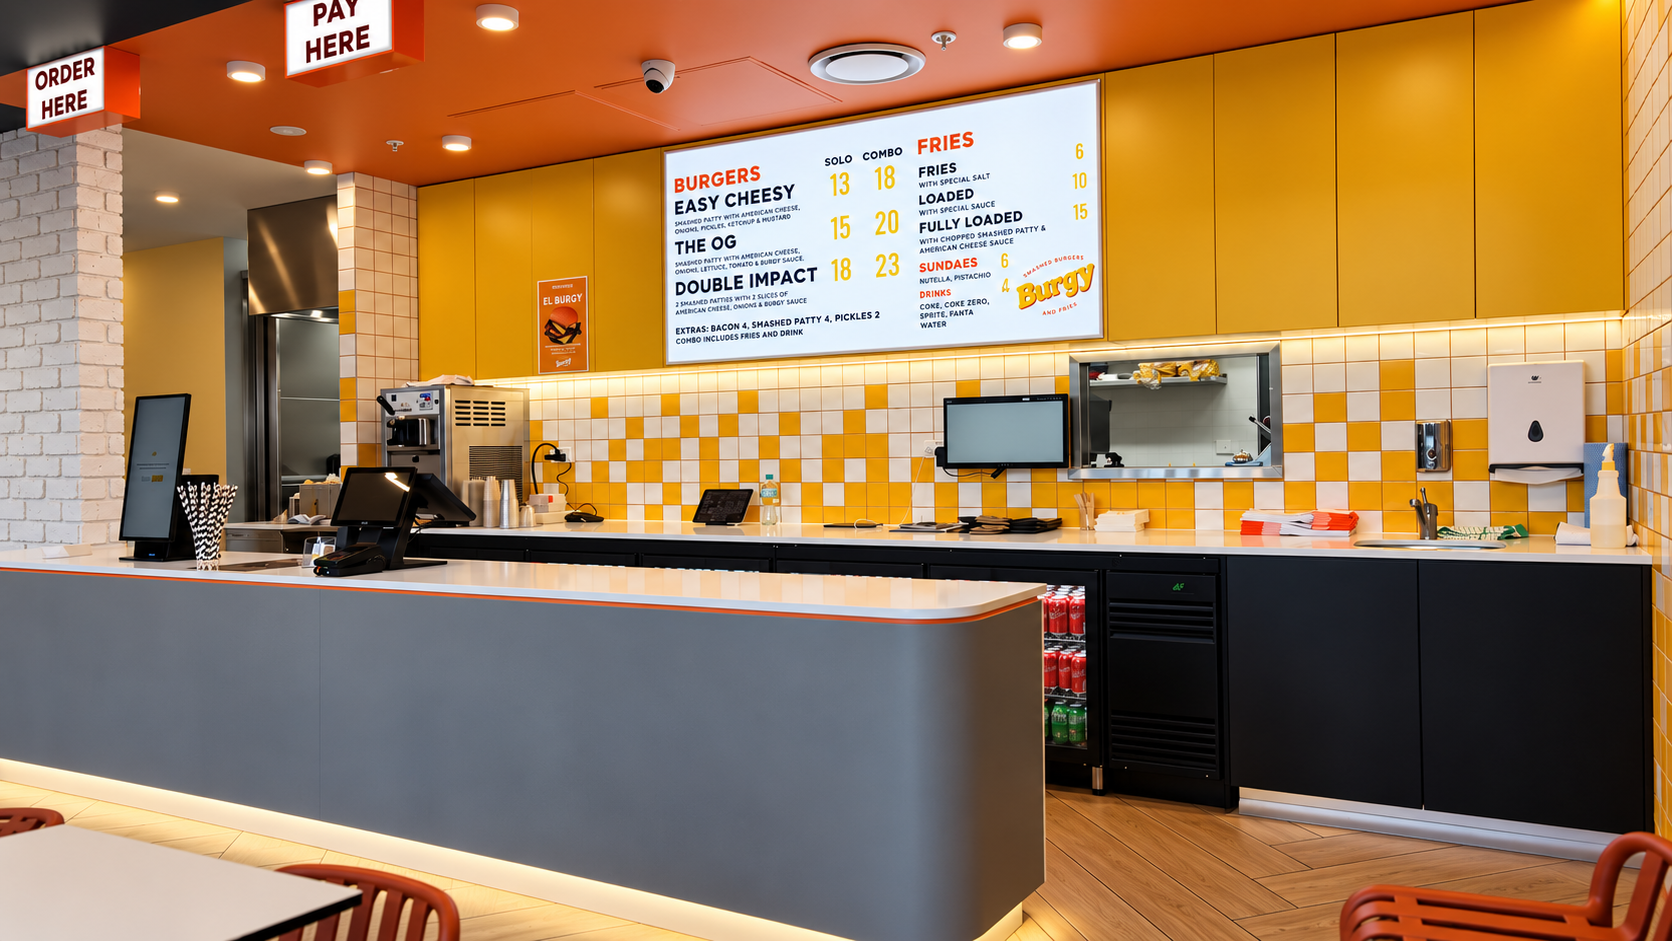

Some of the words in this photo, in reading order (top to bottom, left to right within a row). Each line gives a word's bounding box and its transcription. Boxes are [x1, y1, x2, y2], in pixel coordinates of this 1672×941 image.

[313, 0, 358, 27] PAY
[306, 24, 370, 64] HERE
[35, 57, 95, 91] ORDER
[41, 89, 88, 120] HERE
[917, 131, 974, 155] FRIES
[1075, 143, 1084, 160] 6
[824, 154, 853, 166] SOLO
[862, 147, 903, 161] COMBO
[918, 162, 957, 178] FRIES
[674, 165, 761, 193] BURGERS
[830, 171, 850, 196] 13
[874, 165, 895, 190] 18
[918, 180, 938, 189] WITH
[939, 176, 970, 186] SPECIAL
[972, 172, 991, 181] SALT
[1072, 172, 1087, 189] 10
[675, 195, 719, 215] EASY
[724, 184, 795, 207] CHEESY
[918, 188, 974, 205] LOADED
[741, 209, 774, 218] AMERICAN
[919, 208, 938, 216] WITH
[939, 204, 969, 214] SPECIAL
[971, 200, 996, 210] SAUCE
[1073, 203, 1088, 220] 15
[830, 215, 851, 240] 15
[875, 209, 899, 236] 20
[919, 218, 961, 234] FULLY
[965, 210, 1023, 228] LOADED
[919, 237, 938, 245] WITH
[940, 233, 975, 243] CHOPPED
[977, 228, 1013, 239] SMASHED
[1015, 226, 1039, 234] PATTY
[674, 239, 706, 255] THE
[711, 234, 737, 251] OG
[919, 243, 957, 254] AMERICAN
[959, 241, 987, 250] CHEESE
[989, 237, 1014, 247] SAUCE
[741, 251, 773, 260] AMERICAN
[1001, 252, 1009, 268] 6
[831, 257, 851, 282] 18
[875, 252, 900, 278] 23
[919, 257, 978, 273] SUNDAES
[675, 274, 744, 296] DOUBLE
[749, 267, 817, 288] IMPACT
[919, 275, 952, 285] NUTELLA,
[954, 271, 991, 281] PISTACHIO
[1001, 278, 1010, 293] 4
[1016, 263, 1095, 310] Burgy
[543, 296, 553, 306] EL
[554, 293, 583, 305] BURGY
[734, 294, 751, 302] WITH
[919, 288, 952, 299] DRINKS
[675, 306, 706, 315] AMERICAN
[733, 302, 758, 310] ONIONS
[786, 297, 807, 305] SAUCE
[920, 302, 942, 310] COKE,
[944, 300, 965, 308] COKE
[967, 298, 990, 306] ZERO,
[949, 309, 974, 317] FANTA
[675, 326, 709, 335] EXTRAS:
[711, 323, 740, 333] BACON
[742, 322, 750, 331] 4,
[751, 318, 792, 329] SMASHED
[794, 316, 822, 326] PATTY
[824, 315, 832, 324] 4,
[835, 311, 872, 322] PICKLES
[874, 310, 880, 319] 2
[920, 320, 947, 329] WATER
[675, 337, 702, 345] COMBO
[703, 334, 739, 343] INCLUDES
[740, 332, 761, 340] FRIES
[780, 329, 804, 337] DRINK
